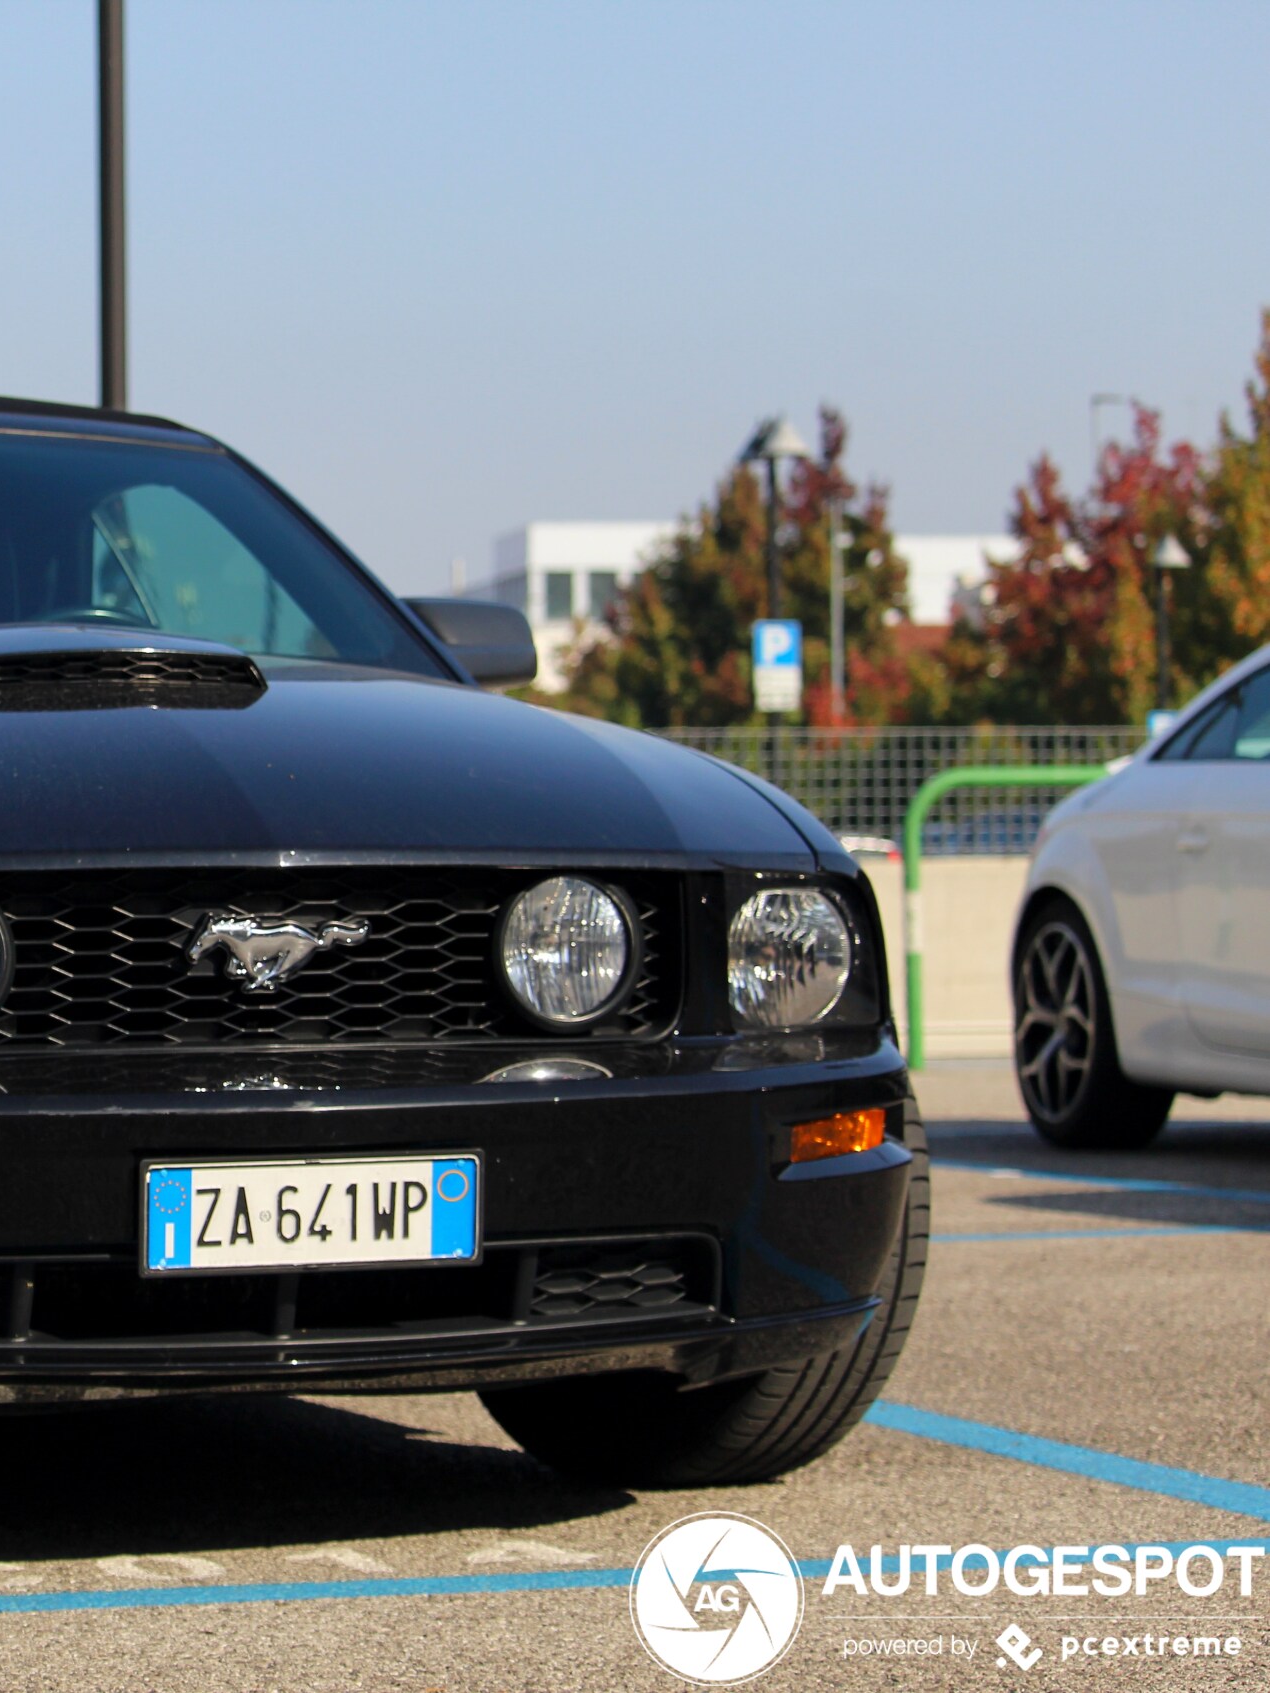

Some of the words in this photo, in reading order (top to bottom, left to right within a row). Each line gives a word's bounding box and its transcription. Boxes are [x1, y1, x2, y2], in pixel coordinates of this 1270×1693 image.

[762, 623, 792, 665] P
[196, 1187, 254, 1247] ZA
[277, 1181, 428, 1243] 641WP
